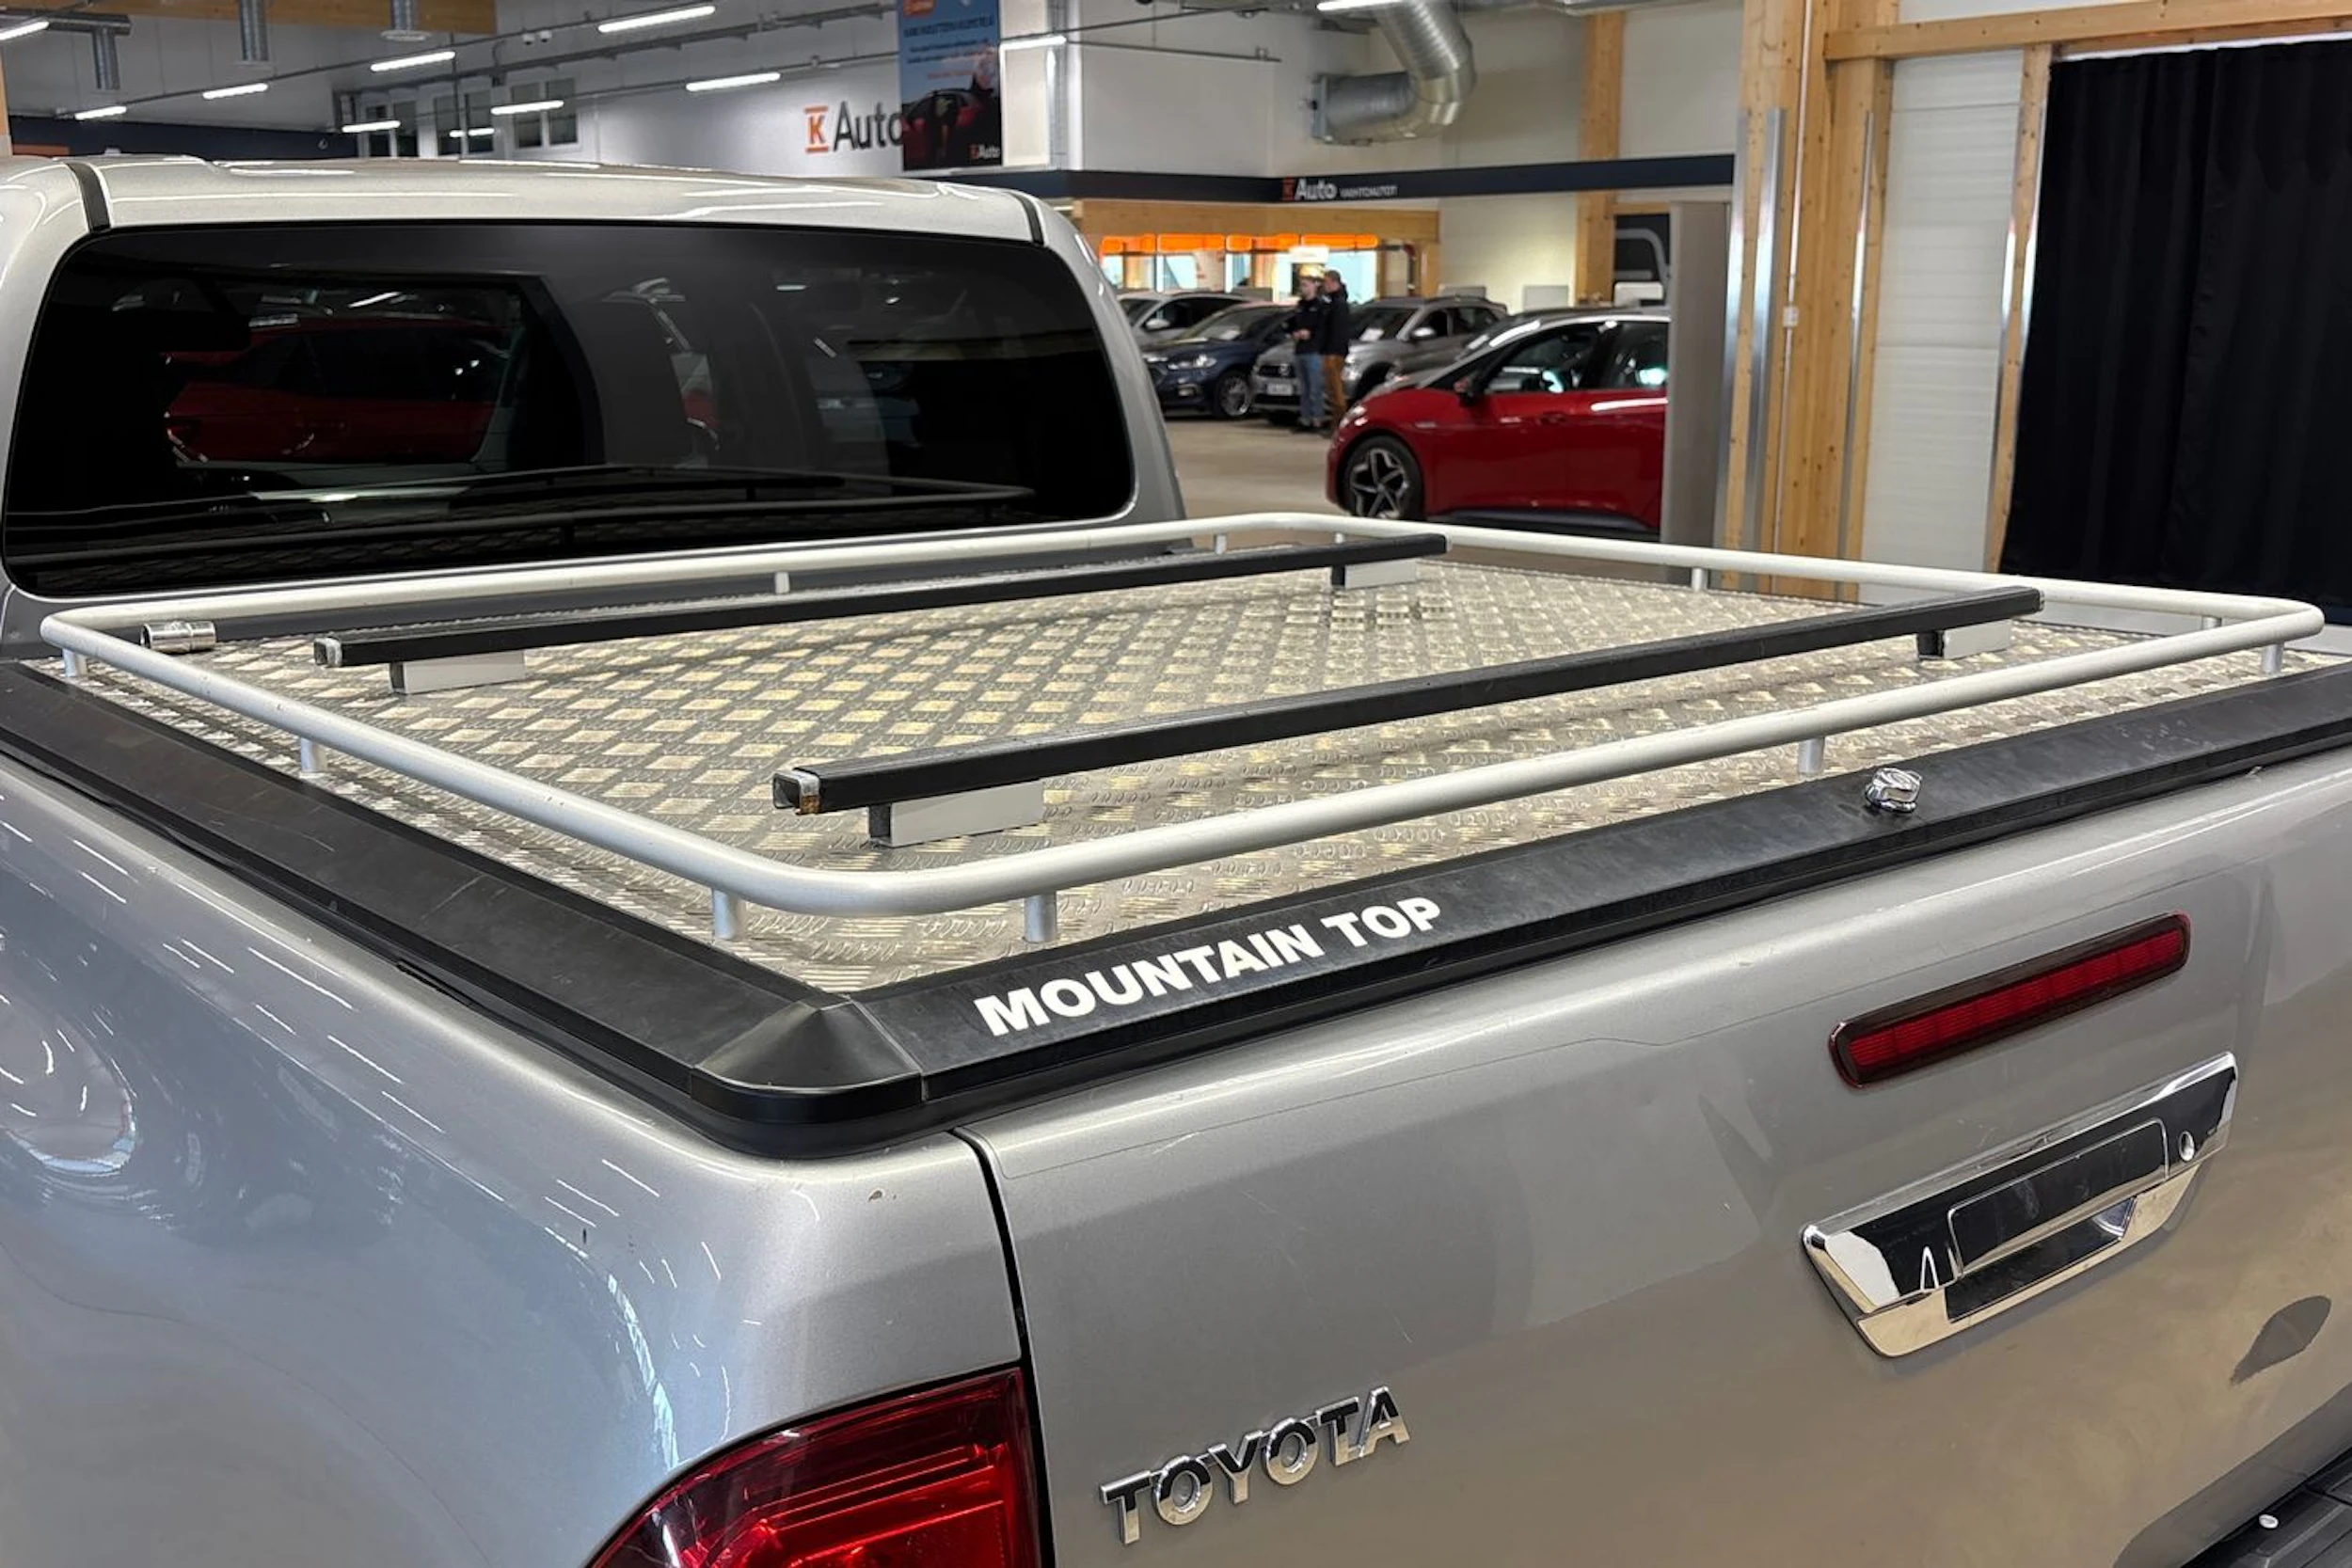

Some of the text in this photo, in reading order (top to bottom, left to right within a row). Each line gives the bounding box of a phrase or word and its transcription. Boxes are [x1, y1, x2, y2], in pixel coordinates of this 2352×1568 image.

[806, 111, 828, 148] K
[1295, 178, 1337, 200] Auto
[973, 897, 1440, 1036] MOUNTAIN TOP
[1100, 1386, 1410, 1545] TOYOTA
